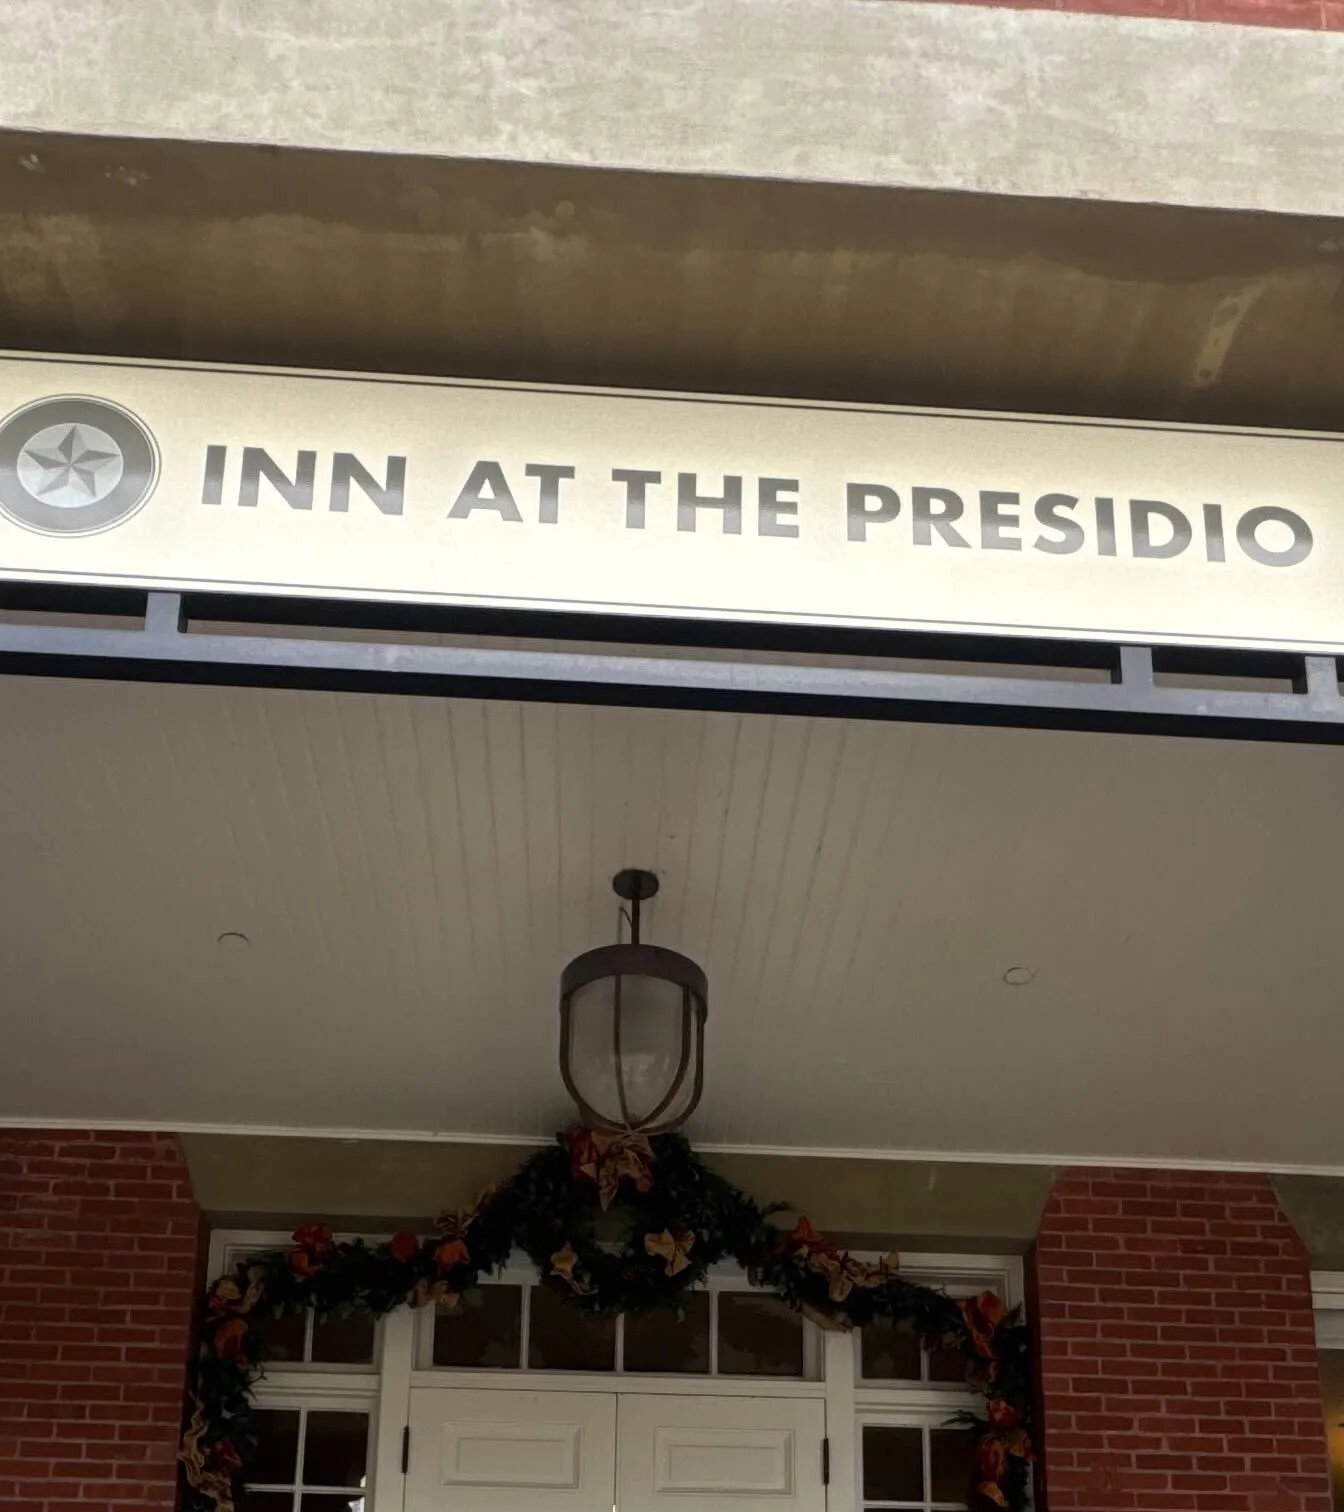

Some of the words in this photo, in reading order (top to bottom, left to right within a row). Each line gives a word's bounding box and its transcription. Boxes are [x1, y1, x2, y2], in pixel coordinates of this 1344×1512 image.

[201, 444, 407, 516] INN
[446, 460, 575, 524] AT
[611, 468, 800, 538] THE
[846, 482, 1314, 568] PRESIDIO
